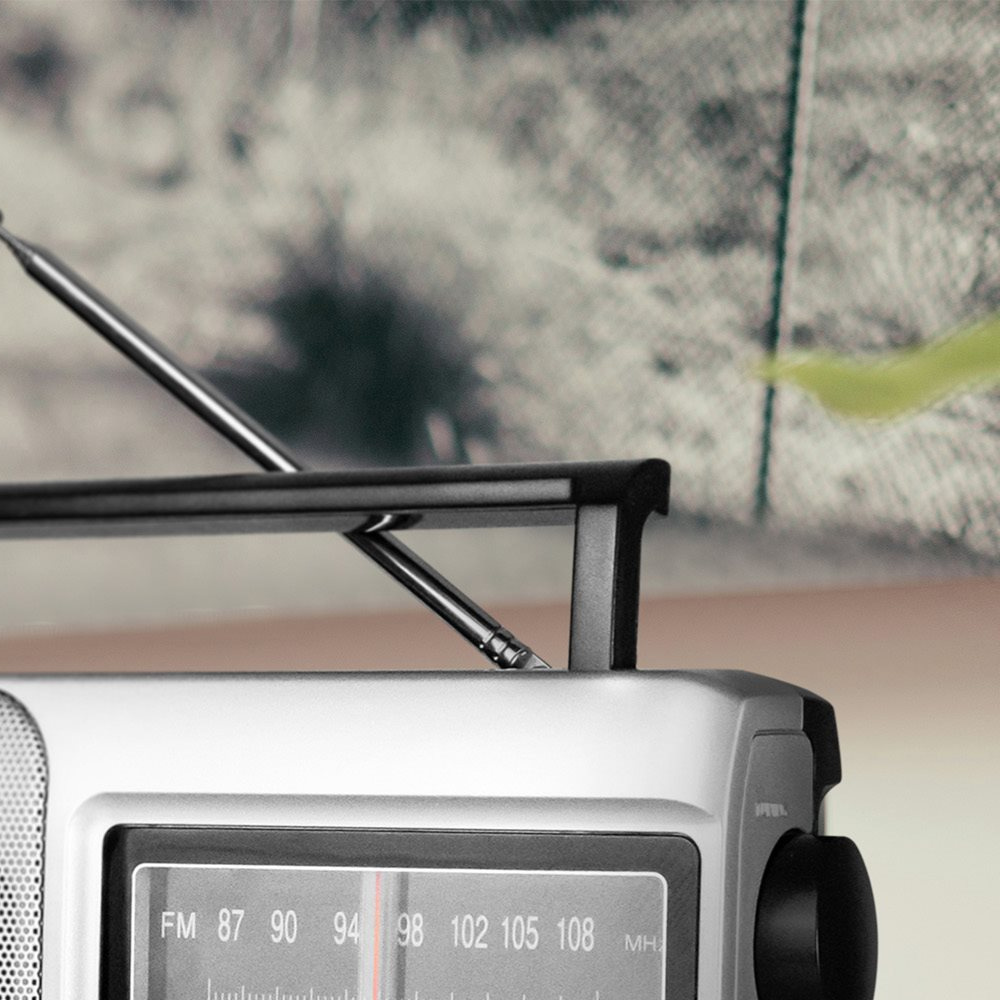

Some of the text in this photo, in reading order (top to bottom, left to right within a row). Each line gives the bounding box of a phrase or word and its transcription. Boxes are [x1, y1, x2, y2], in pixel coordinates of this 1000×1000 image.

[161, 911, 196, 939] FM
[218, 908, 245, 942] 87
[271, 909, 298, 944] 90
[334, 911, 359, 945] 94
[399, 912, 424, 947] 98
[451, 914, 489, 949] 102
[502, 915, 539, 950] 105
[557, 917, 594, 951] 108
